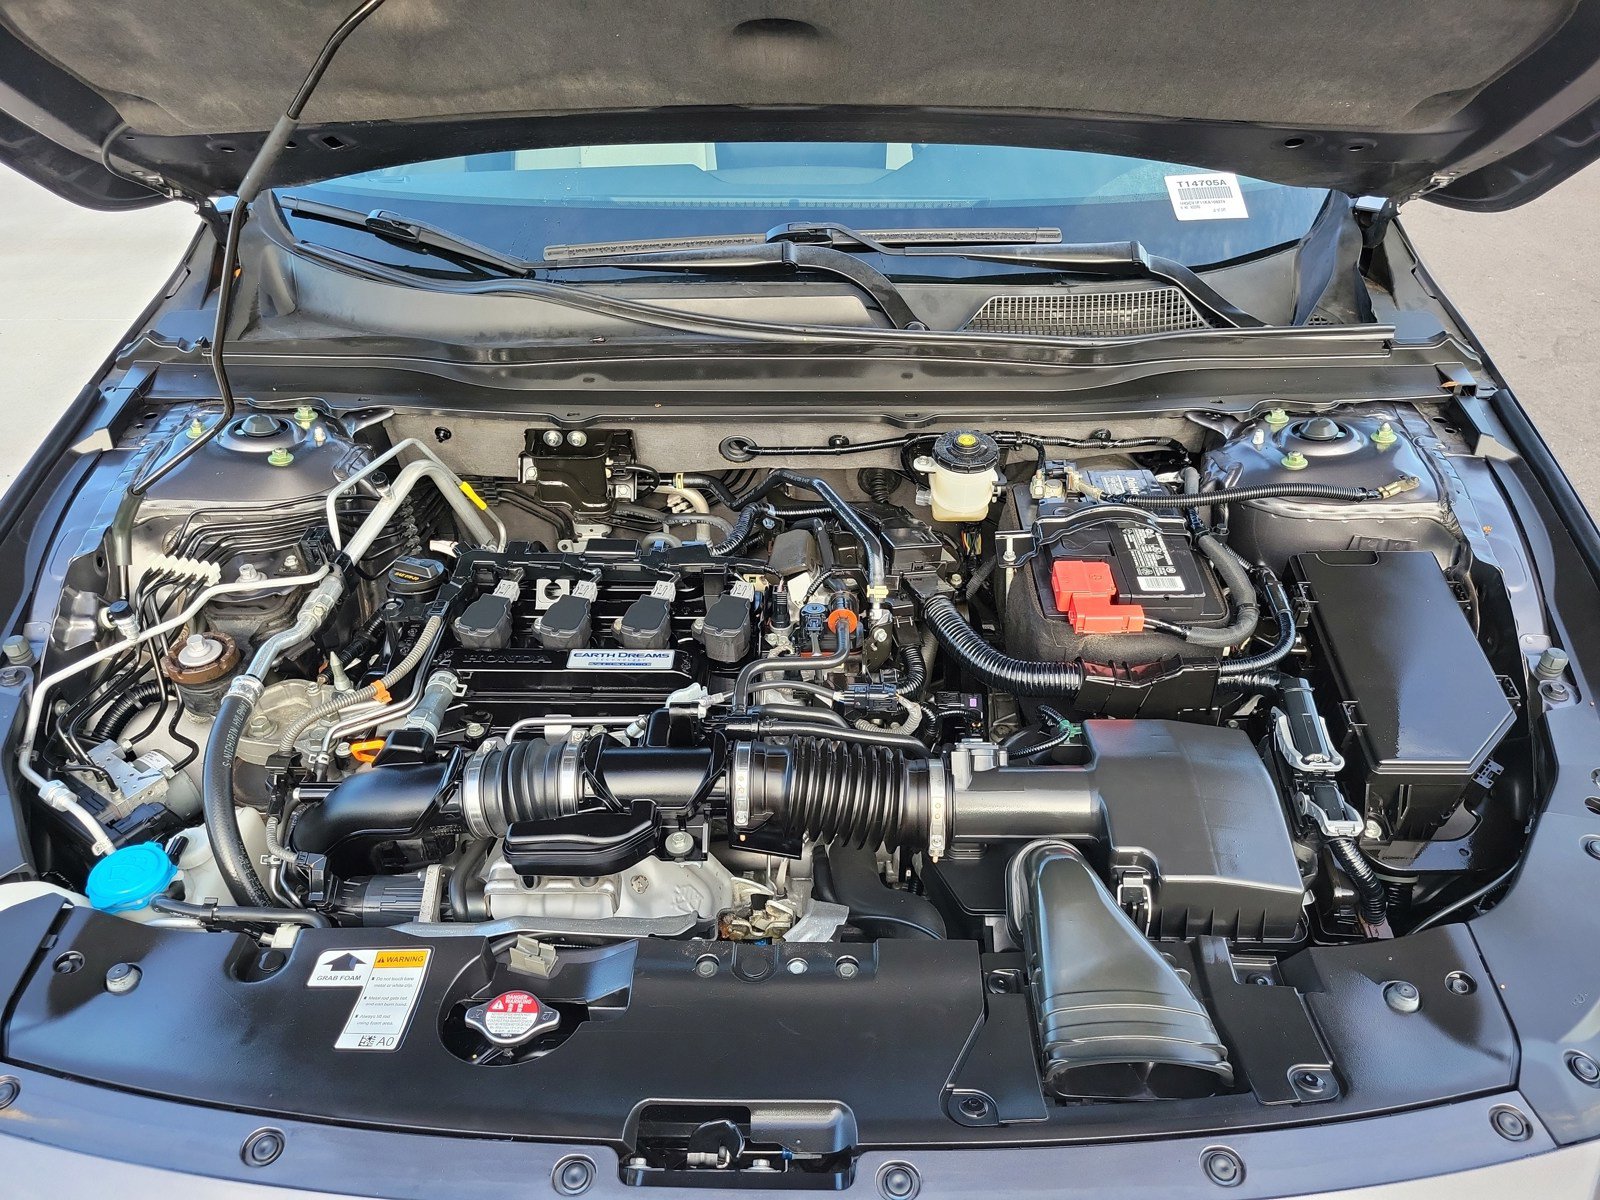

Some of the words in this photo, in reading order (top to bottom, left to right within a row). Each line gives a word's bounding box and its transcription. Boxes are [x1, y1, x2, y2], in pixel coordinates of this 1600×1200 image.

[1176, 179, 1227, 188] T14705A
[463, 654, 552, 664] HONDA
[385, 955, 424, 963] WARNING
